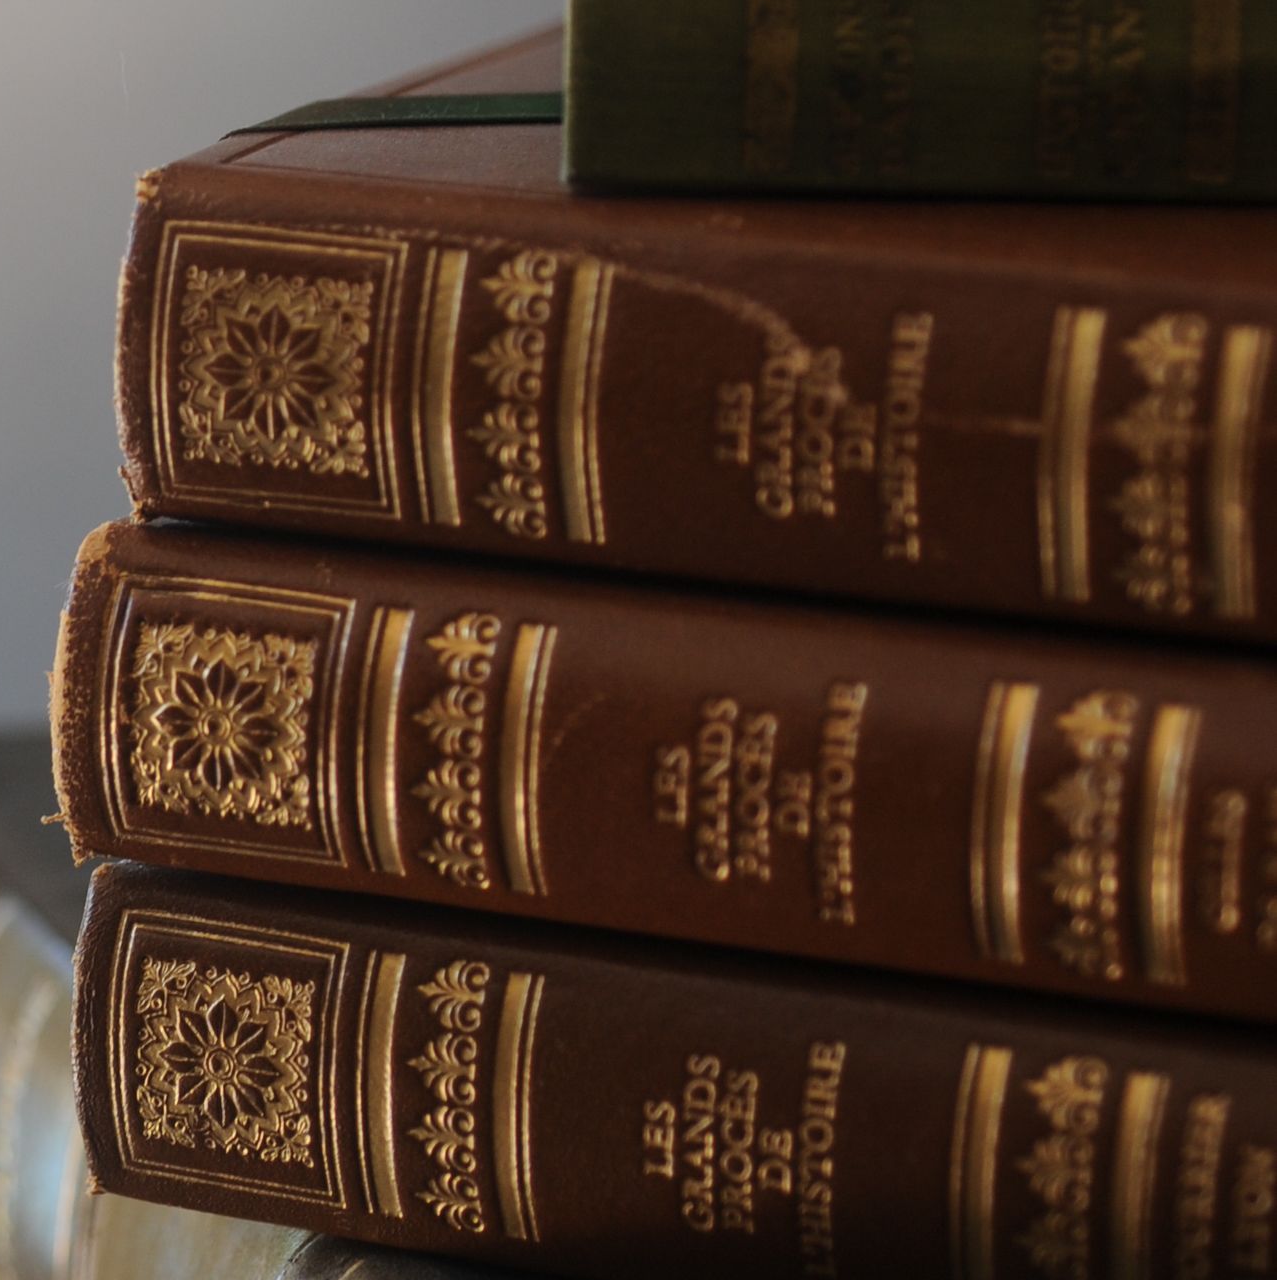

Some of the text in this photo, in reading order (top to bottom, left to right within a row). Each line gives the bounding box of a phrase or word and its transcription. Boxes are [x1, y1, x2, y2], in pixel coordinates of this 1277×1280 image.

[714, 381, 754, 465] LES
[754, 334, 800, 519] GRANDS
[837, 403, 877, 472] DE
[880, 311, 935, 563] L'HISTOIRE
[652, 744, 692, 828] LES
[693, 696, 739, 883] GRANDS
[773, 770, 814, 839] DE
[814, 681, 870, 927] L'HISTOIRE
[641, 1098, 677, 1180] LES
[680, 1052, 722, 1233] GRANDS
[756, 1126, 794, 1196] DE
[797, 1039, 848, 1280] L'HISTOIRE
